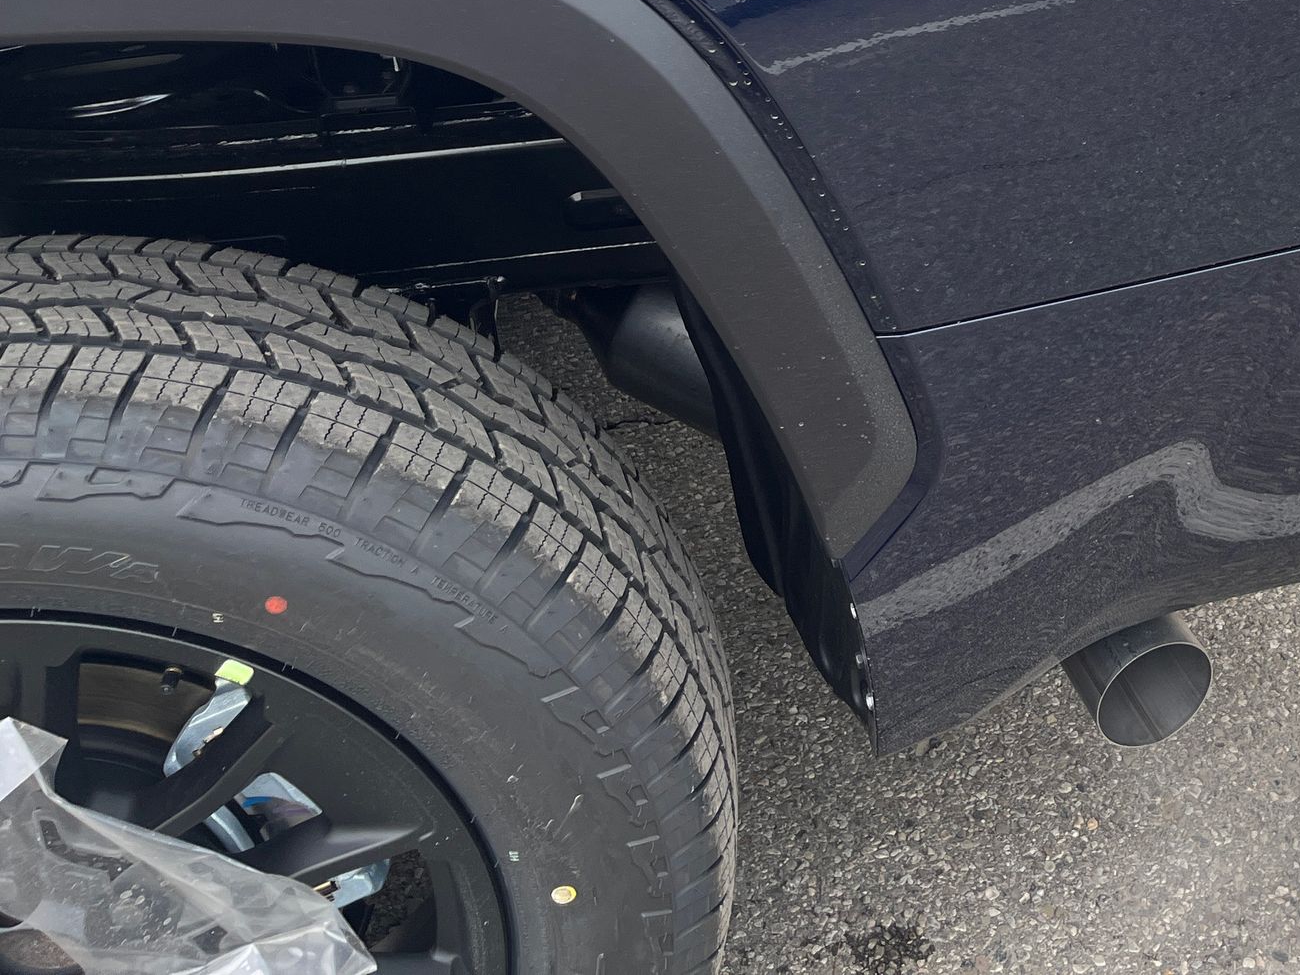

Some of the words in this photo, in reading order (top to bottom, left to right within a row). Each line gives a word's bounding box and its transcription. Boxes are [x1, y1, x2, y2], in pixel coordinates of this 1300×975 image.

[240, 498, 311, 526] TREADWEAR
[318, 522, 342, 538] 500
[354, 536, 407, 568] TRACTION
[430, 576, 498, 625] TEMPERATURE
